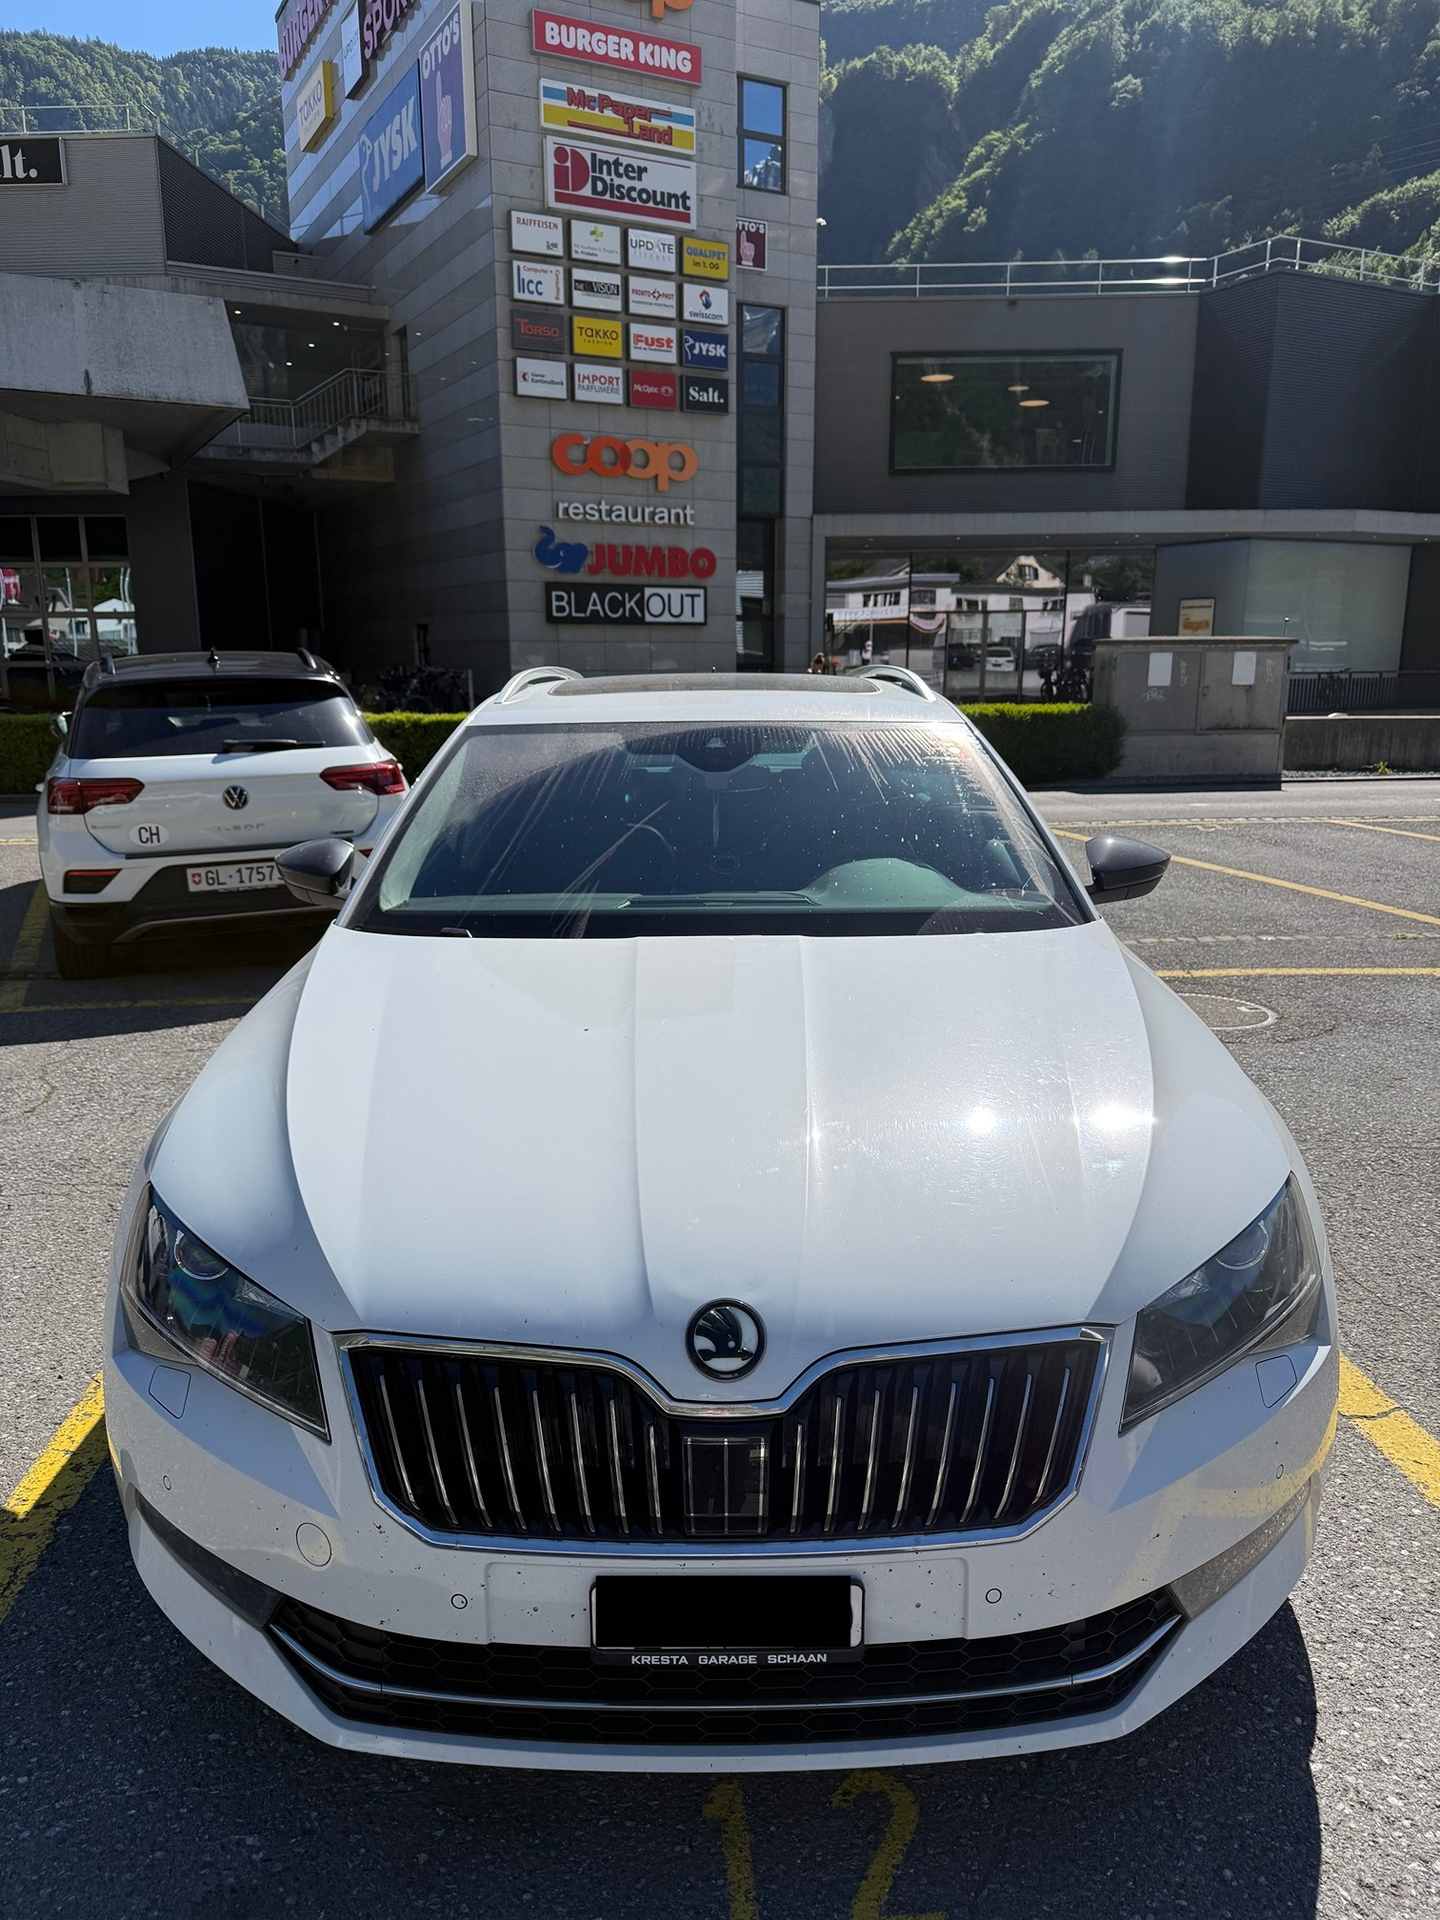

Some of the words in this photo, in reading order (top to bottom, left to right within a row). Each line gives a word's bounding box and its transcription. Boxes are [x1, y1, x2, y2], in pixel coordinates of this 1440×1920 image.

[421, 12, 460, 80] OTTO'S
[545, 21, 634, 62] BURGER
[638, 41, 692, 74] KING
[627, 118, 673, 145] Land
[372, 95, 418, 192] JYSK
[0, 144, 38, 179] lt.
[590, 152, 648, 182] Inter
[590, 176, 691, 211] Discount
[516, 217, 558, 230] RAIFFEISEN
[686, 246, 727, 260] QUALIPET
[592, 281, 618, 295] VISION
[689, 310, 723, 320] swisscom
[633, 333, 674, 349] Fust
[692, 341, 727, 358] JYSK
[577, 373, 621, 387] IMPORT
[689, 386, 724, 404] Salt.
[552, 433, 698, 492] coop
[557, 500, 695, 526] restaurant
[587, 543, 717, 579] JUMBO
[138, 825, 161, 844] CH
[631, 1655, 689, 1664] KRESTA
[698, 1655, 757, 1664] GARAGE
[767, 1654, 827, 1664] SCHAAN
